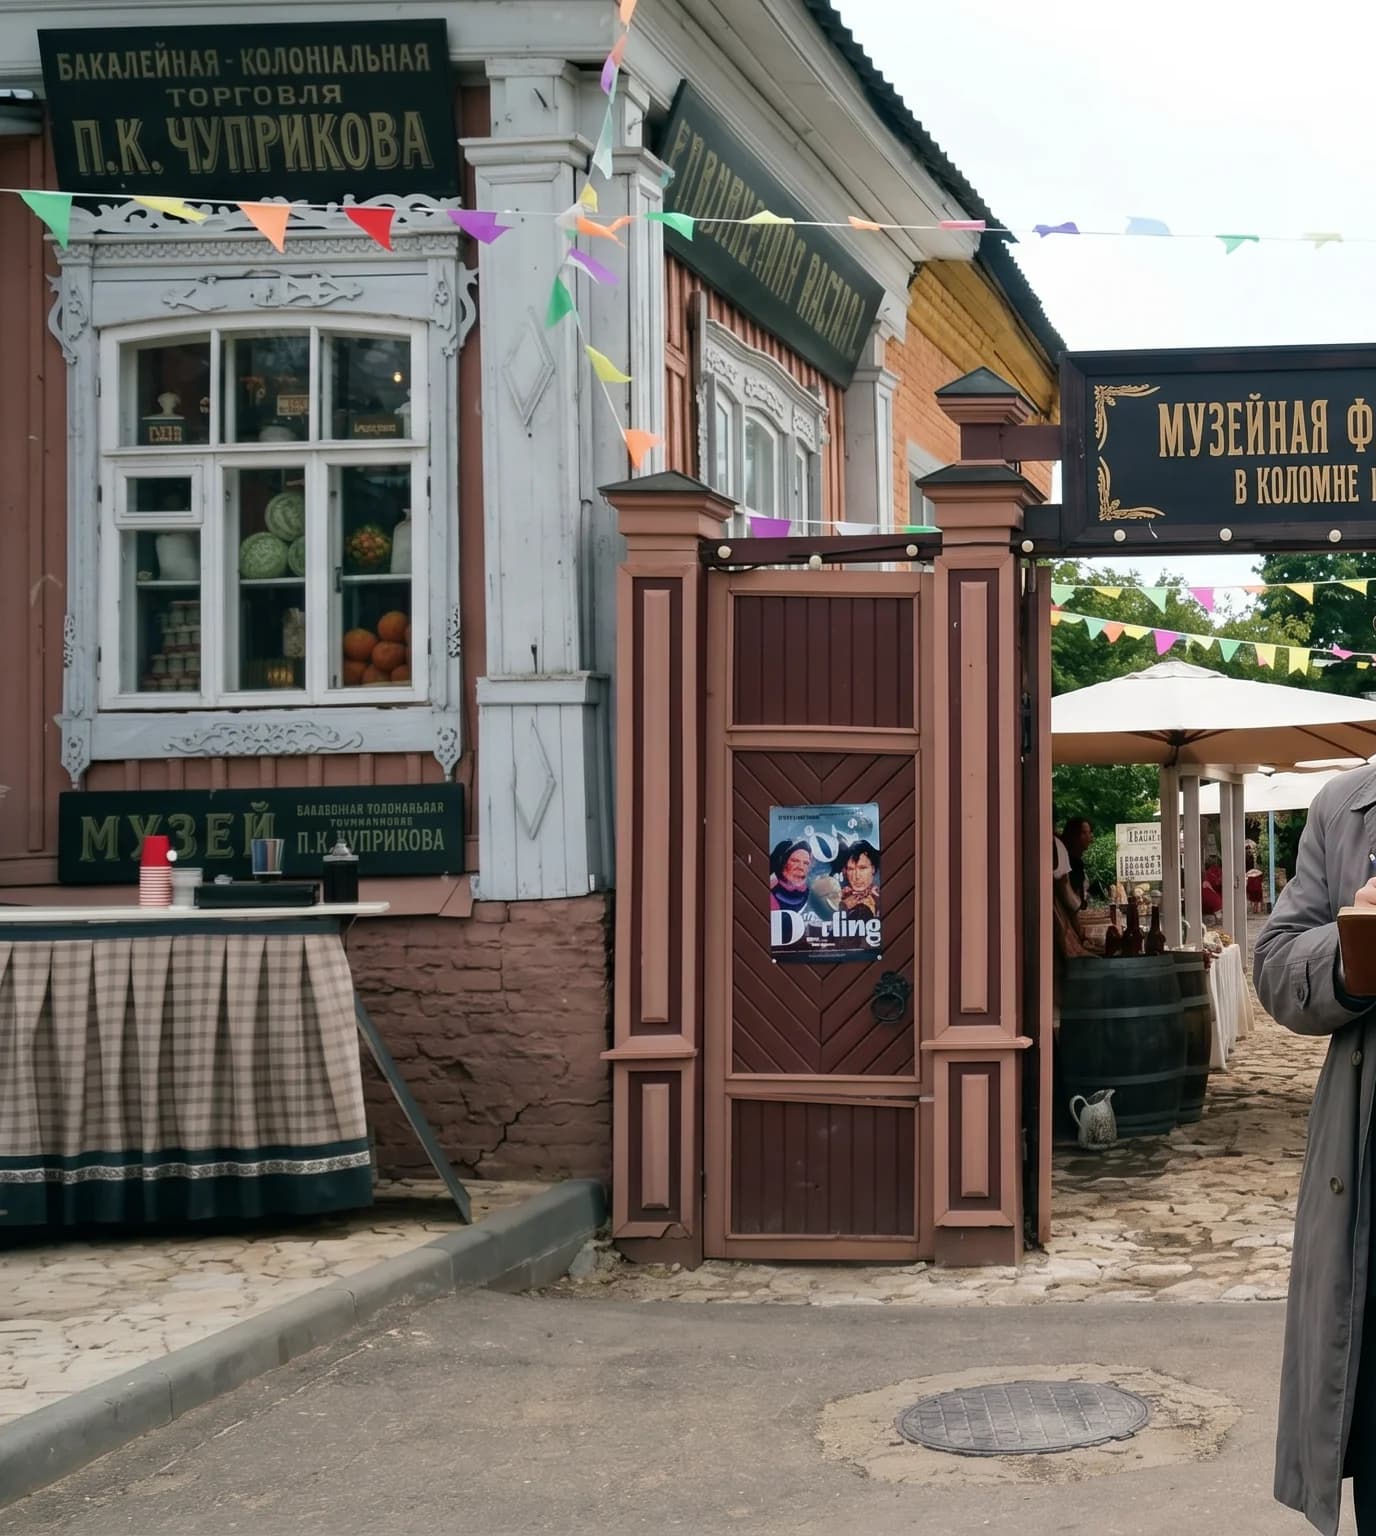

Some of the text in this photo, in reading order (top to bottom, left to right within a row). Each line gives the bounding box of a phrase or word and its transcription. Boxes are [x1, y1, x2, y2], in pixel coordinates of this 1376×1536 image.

[57, 42, 220, 80] БАКАЛЕЙНАЯ
[241, 43, 431, 76] КОЛОНІАЛЬНАЯ
[165, 85, 342, 108] ТОРГОВЛЯ
[72, 111, 434, 175] П.К. ЧУПРИКОВА
[1158, 393, 1329, 457] МУЗЕЙНАЯ
[1234, 469, 1248, 504] В
[1256, 464, 1360, 504] КОЛОМНЕ
[80, 801, 275, 862] МУЗЕЙ
